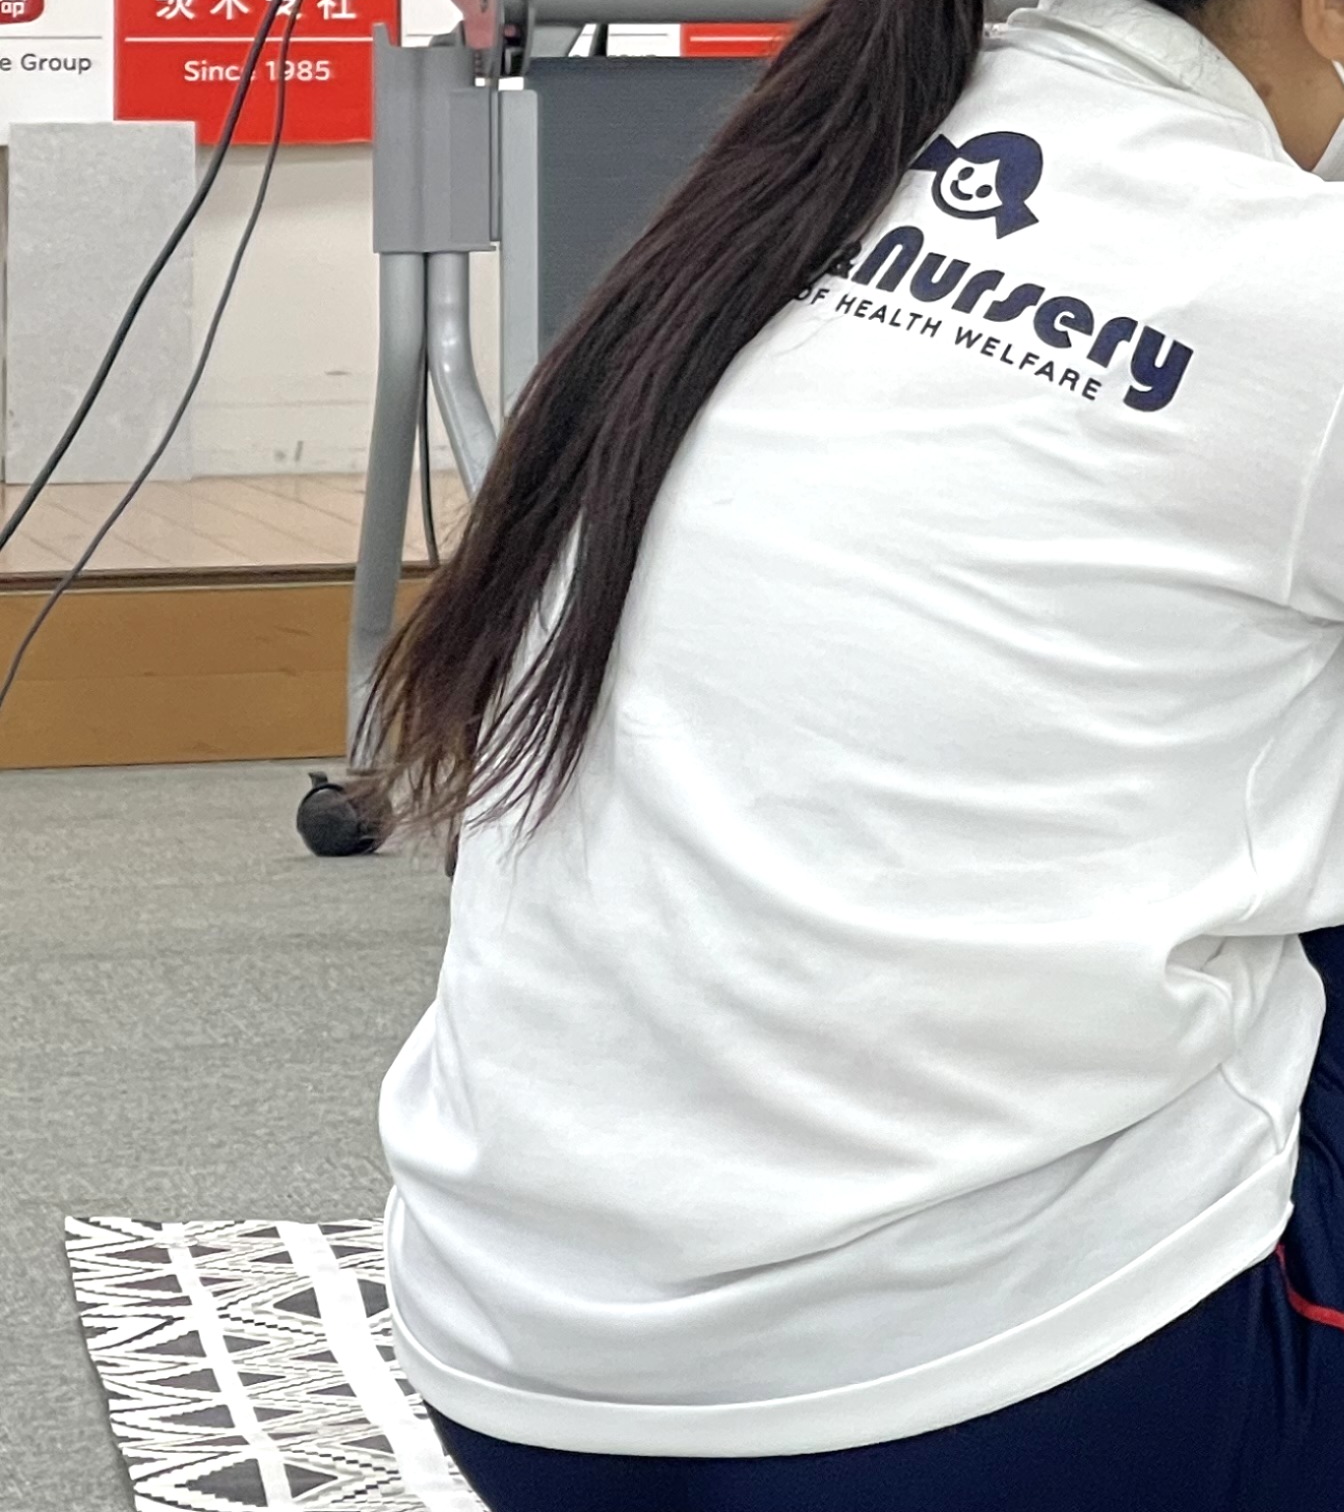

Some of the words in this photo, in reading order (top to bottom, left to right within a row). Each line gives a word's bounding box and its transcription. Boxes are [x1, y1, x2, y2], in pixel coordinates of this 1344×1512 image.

[20, 53, 92, 75] Group
[184, 59, 257, 82] Sinc
[265, 59, 332, 82] 1985
[835, 293, 942, 339] HEALTH
[955, 325, 1102, 401] WELFARE
